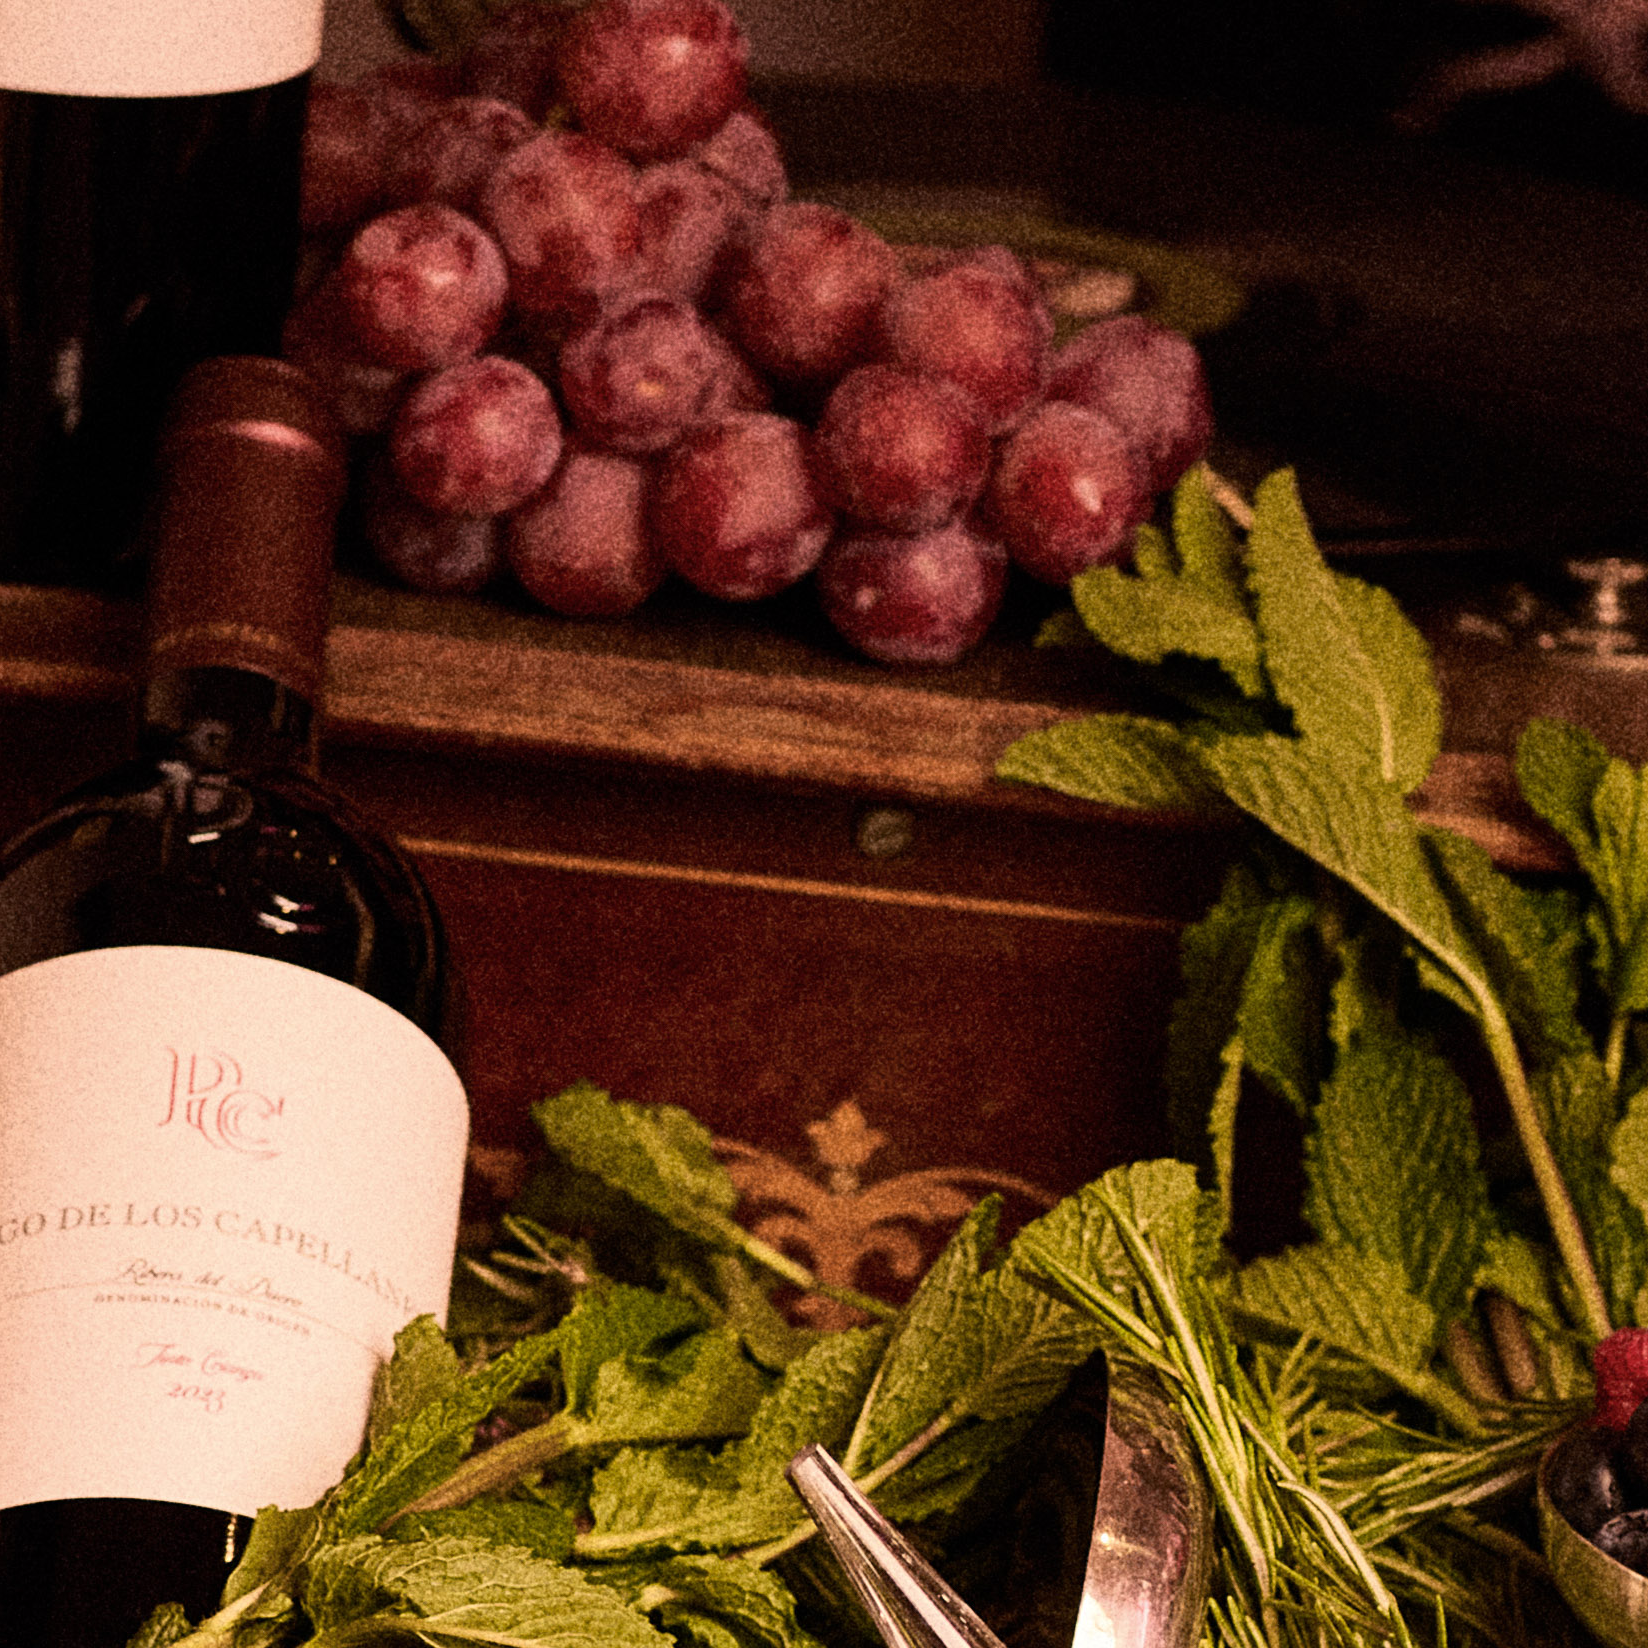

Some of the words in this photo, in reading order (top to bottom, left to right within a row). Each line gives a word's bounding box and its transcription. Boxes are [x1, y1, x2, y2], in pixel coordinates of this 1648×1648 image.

[58, 1202, 112, 1231] DE
[123, 1202, 203, 1229] LOS
[212, 1209, 417, 1316] CAPELLAN
